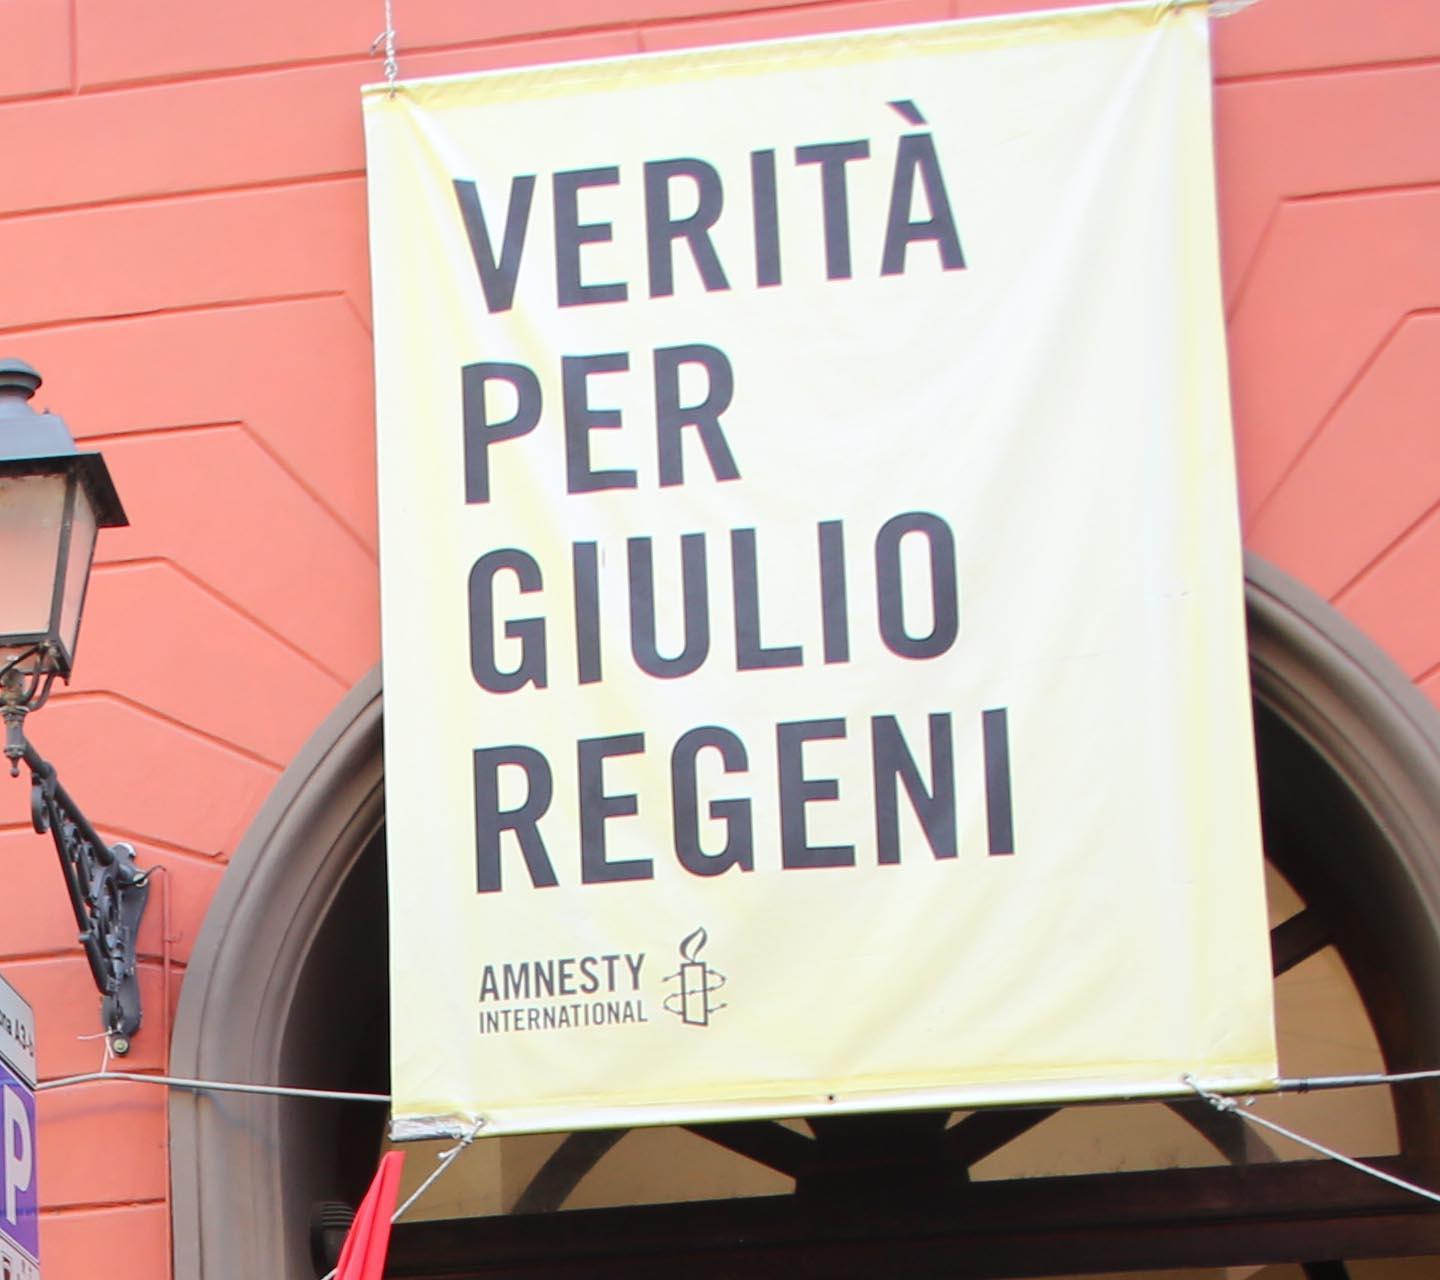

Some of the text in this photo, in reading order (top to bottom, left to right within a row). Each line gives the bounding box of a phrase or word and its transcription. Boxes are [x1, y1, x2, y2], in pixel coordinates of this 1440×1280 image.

[454, 101, 964, 312] VERITÀ
[462, 345, 739, 503] PER
[469, 512, 958, 693] GIULIO
[474, 709, 1013, 893] REGENI
[480, 954, 644, 1003] AMNESTY
[480, 1000, 647, 1033] INTERNATIONAL
[2, 1083, 33, 1225] P
